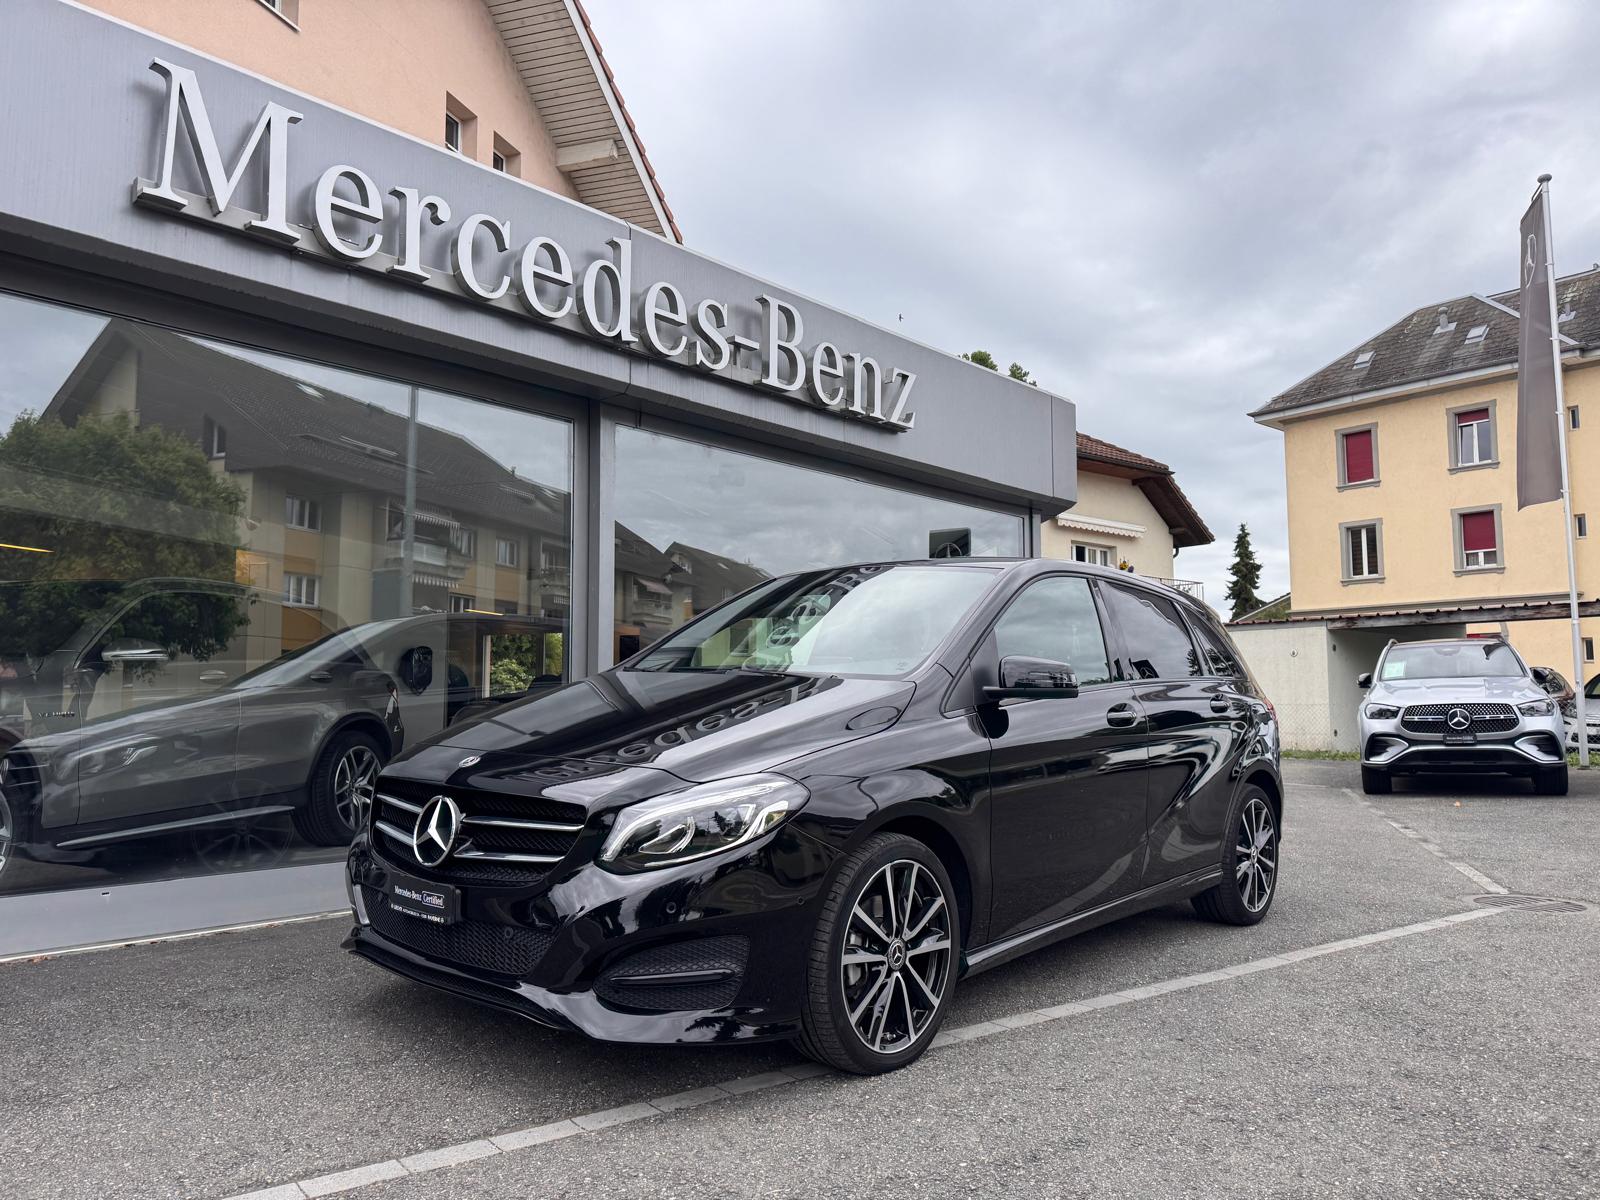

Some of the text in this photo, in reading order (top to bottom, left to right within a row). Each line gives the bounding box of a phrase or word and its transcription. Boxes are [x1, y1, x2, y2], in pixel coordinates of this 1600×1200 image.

[135, 57, 917, 432] Mercedes-Benz
[394, 885, 444, 907] Mercedes-Benz Certified
